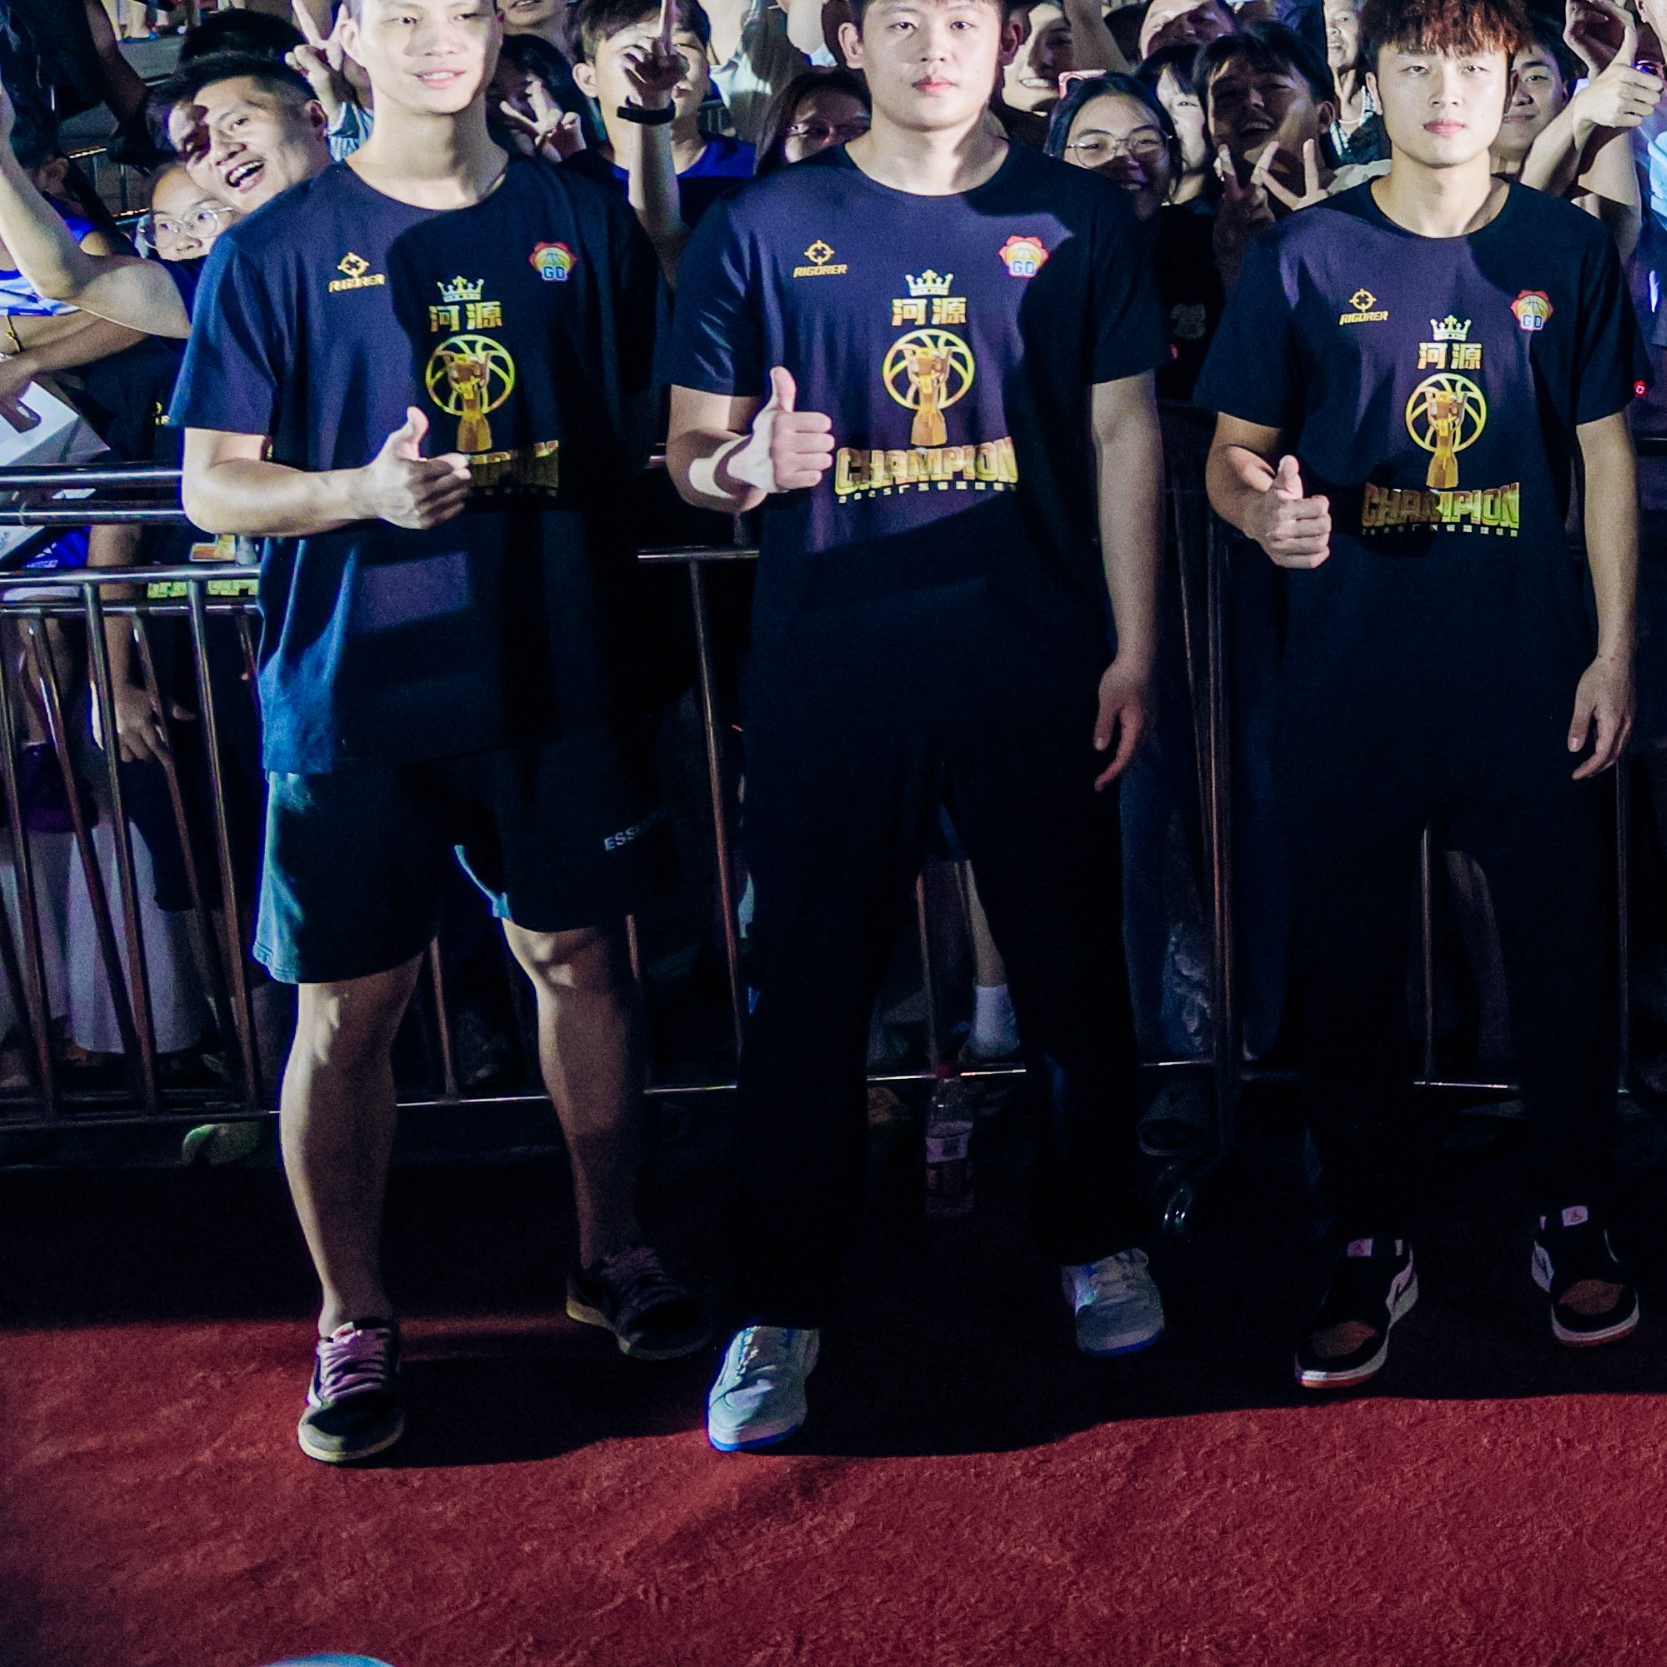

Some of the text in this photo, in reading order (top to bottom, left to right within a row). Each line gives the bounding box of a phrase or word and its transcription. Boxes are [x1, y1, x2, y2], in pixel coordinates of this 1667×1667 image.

[541, 264, 568, 282] GD
[793, 263, 848, 279] RIGORER
[1012, 260, 1036, 276] GD
[427, 301, 503, 332] 河源
[891, 296, 967, 326] 河源
[1338, 310, 1389, 326] RIGORER
[1522, 314, 1543, 330] GD
[1417, 342, 1483, 371] 河源
[834, 436, 1020, 497] CHAMPION
[1361, 481, 1521, 530] CHAMPION
